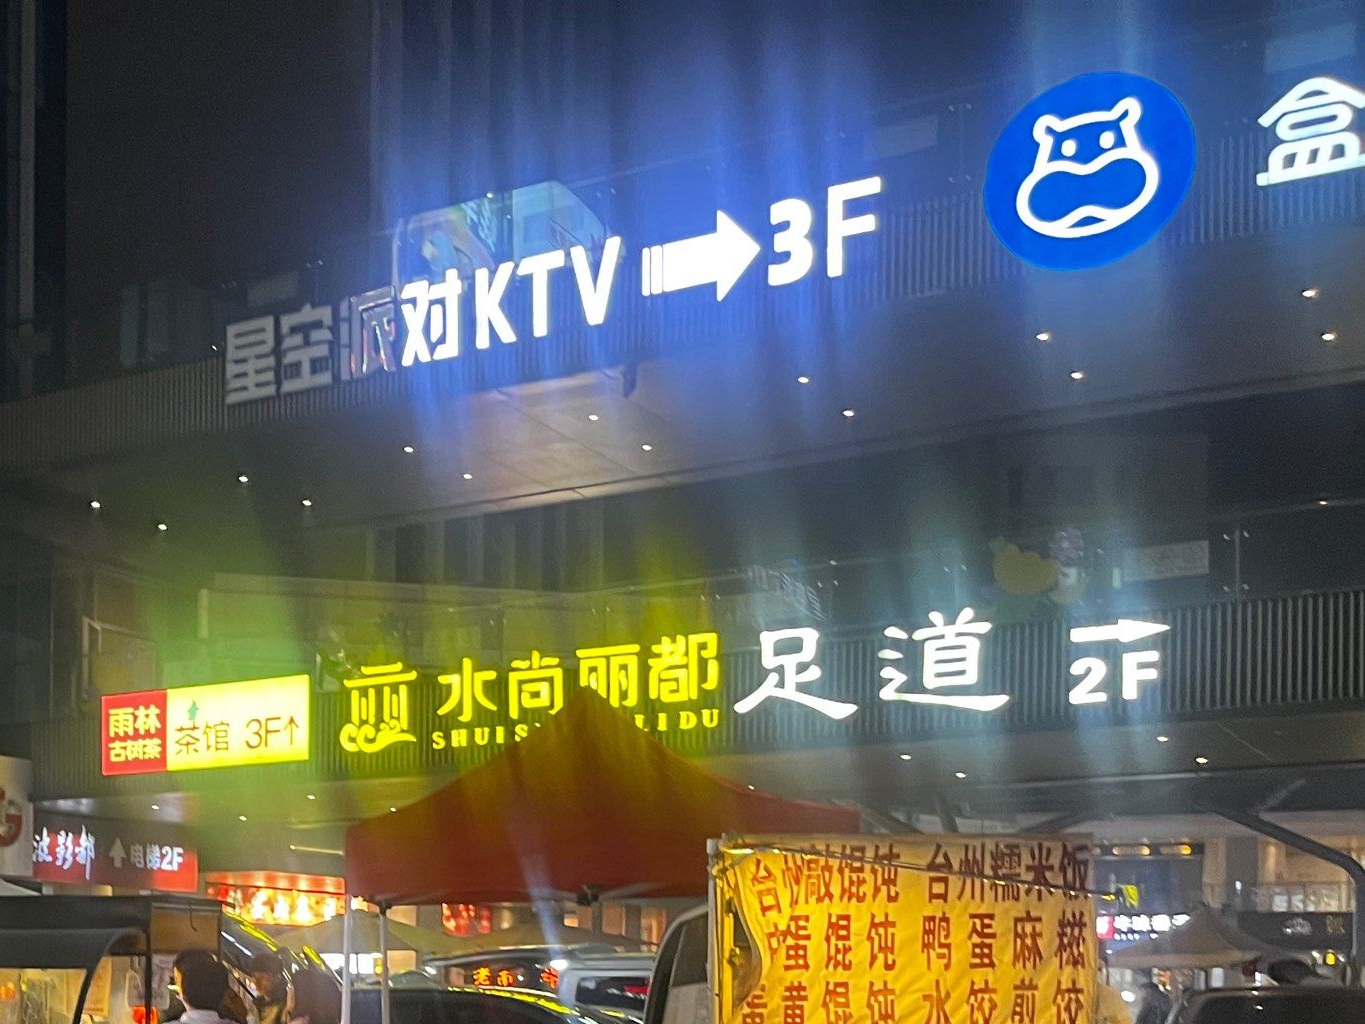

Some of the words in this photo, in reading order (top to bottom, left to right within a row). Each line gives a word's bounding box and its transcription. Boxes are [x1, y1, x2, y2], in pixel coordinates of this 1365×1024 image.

[1255, 76, 1365, 187] 盒
[767, 176, 882, 287] 3F
[436, 632, 719, 723] 水尚丽都
[733, 607, 1010, 720] 足道
[1068, 650, 1161, 705] 2F
[107, 704, 162, 738] 雨林
[108, 738, 162, 762] 古树茶
[174, 720, 231, 756] 茶馆
[244, 716, 282, 750] 3F
